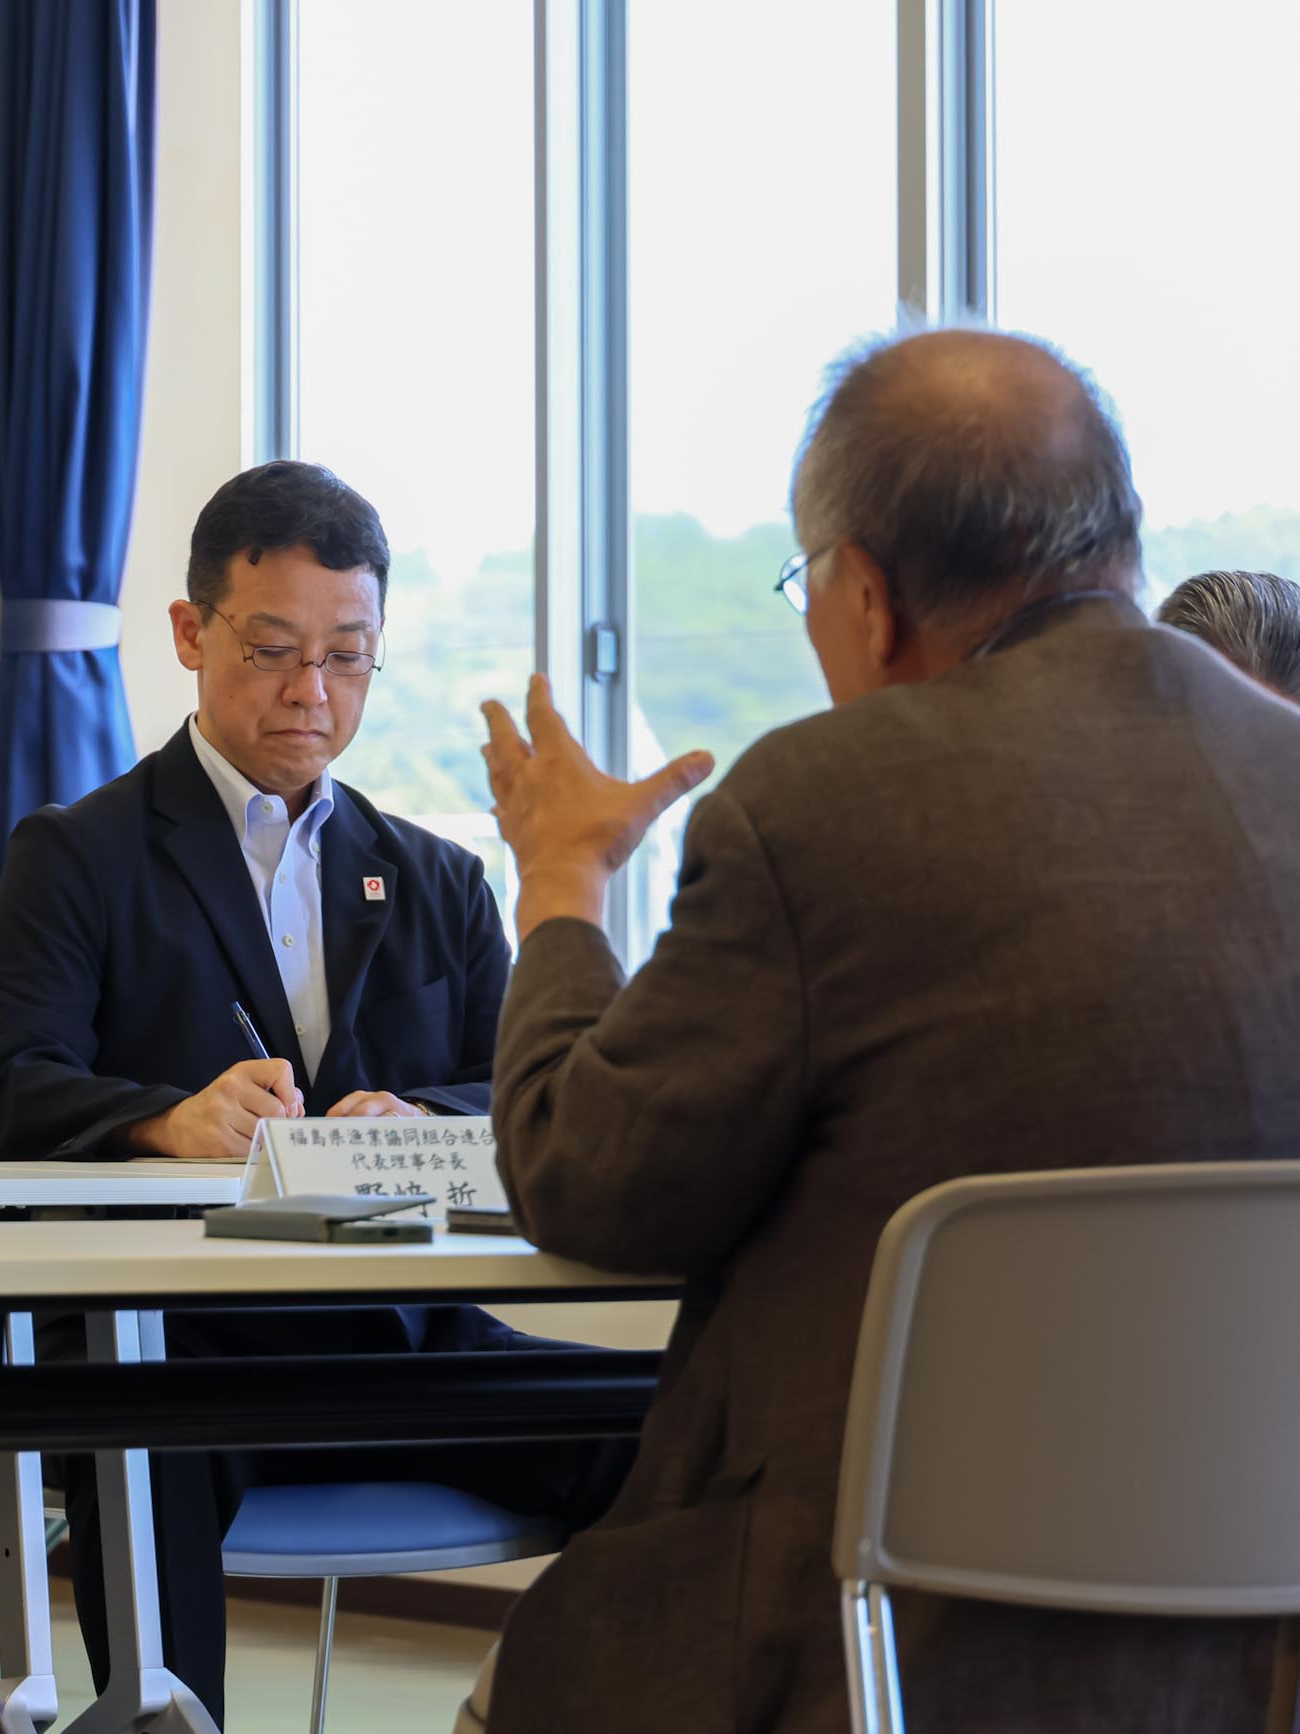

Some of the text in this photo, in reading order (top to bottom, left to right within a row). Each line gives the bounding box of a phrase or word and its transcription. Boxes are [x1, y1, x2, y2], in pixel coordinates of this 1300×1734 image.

[351, 1151, 467, 1171] 代表理事会長
